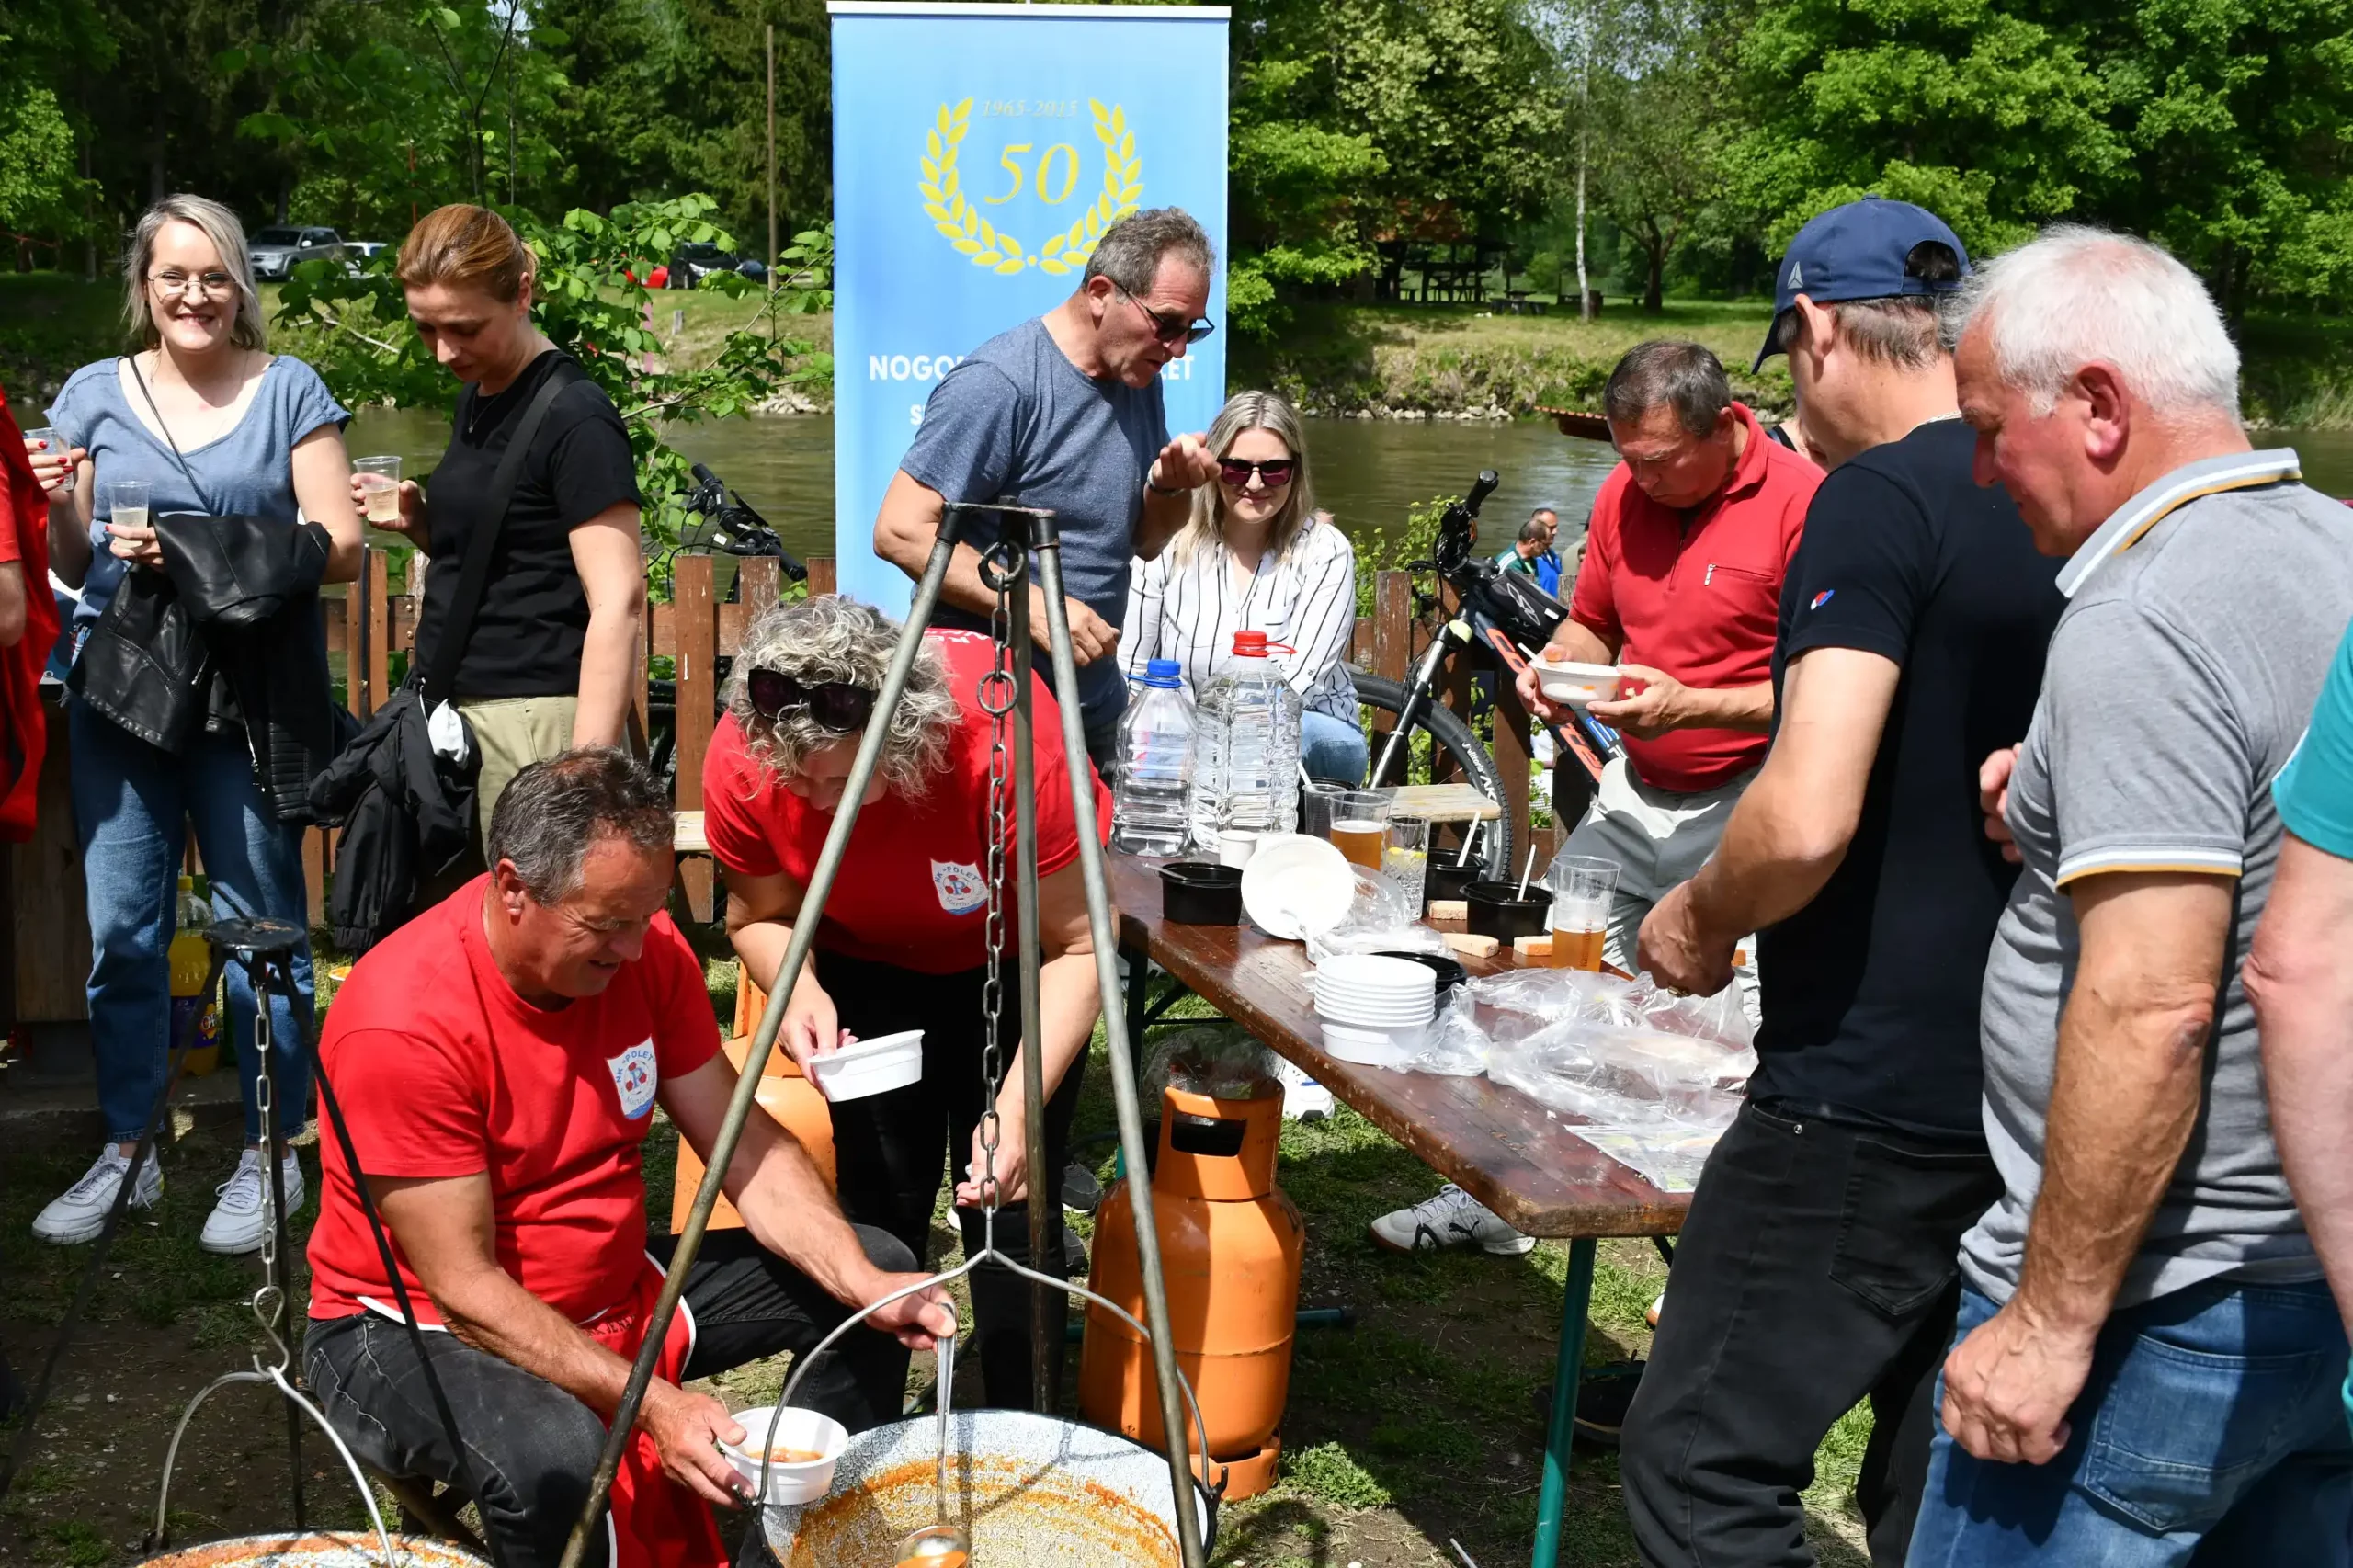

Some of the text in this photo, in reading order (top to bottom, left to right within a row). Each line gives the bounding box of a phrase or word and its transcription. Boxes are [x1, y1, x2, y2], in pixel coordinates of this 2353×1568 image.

[982, 99, 1079, 119] 1965-2015
[983, 142, 1081, 205] 50
[869, 354, 965, 381] NOGO
[1479, 775, 1498, 801] AK
